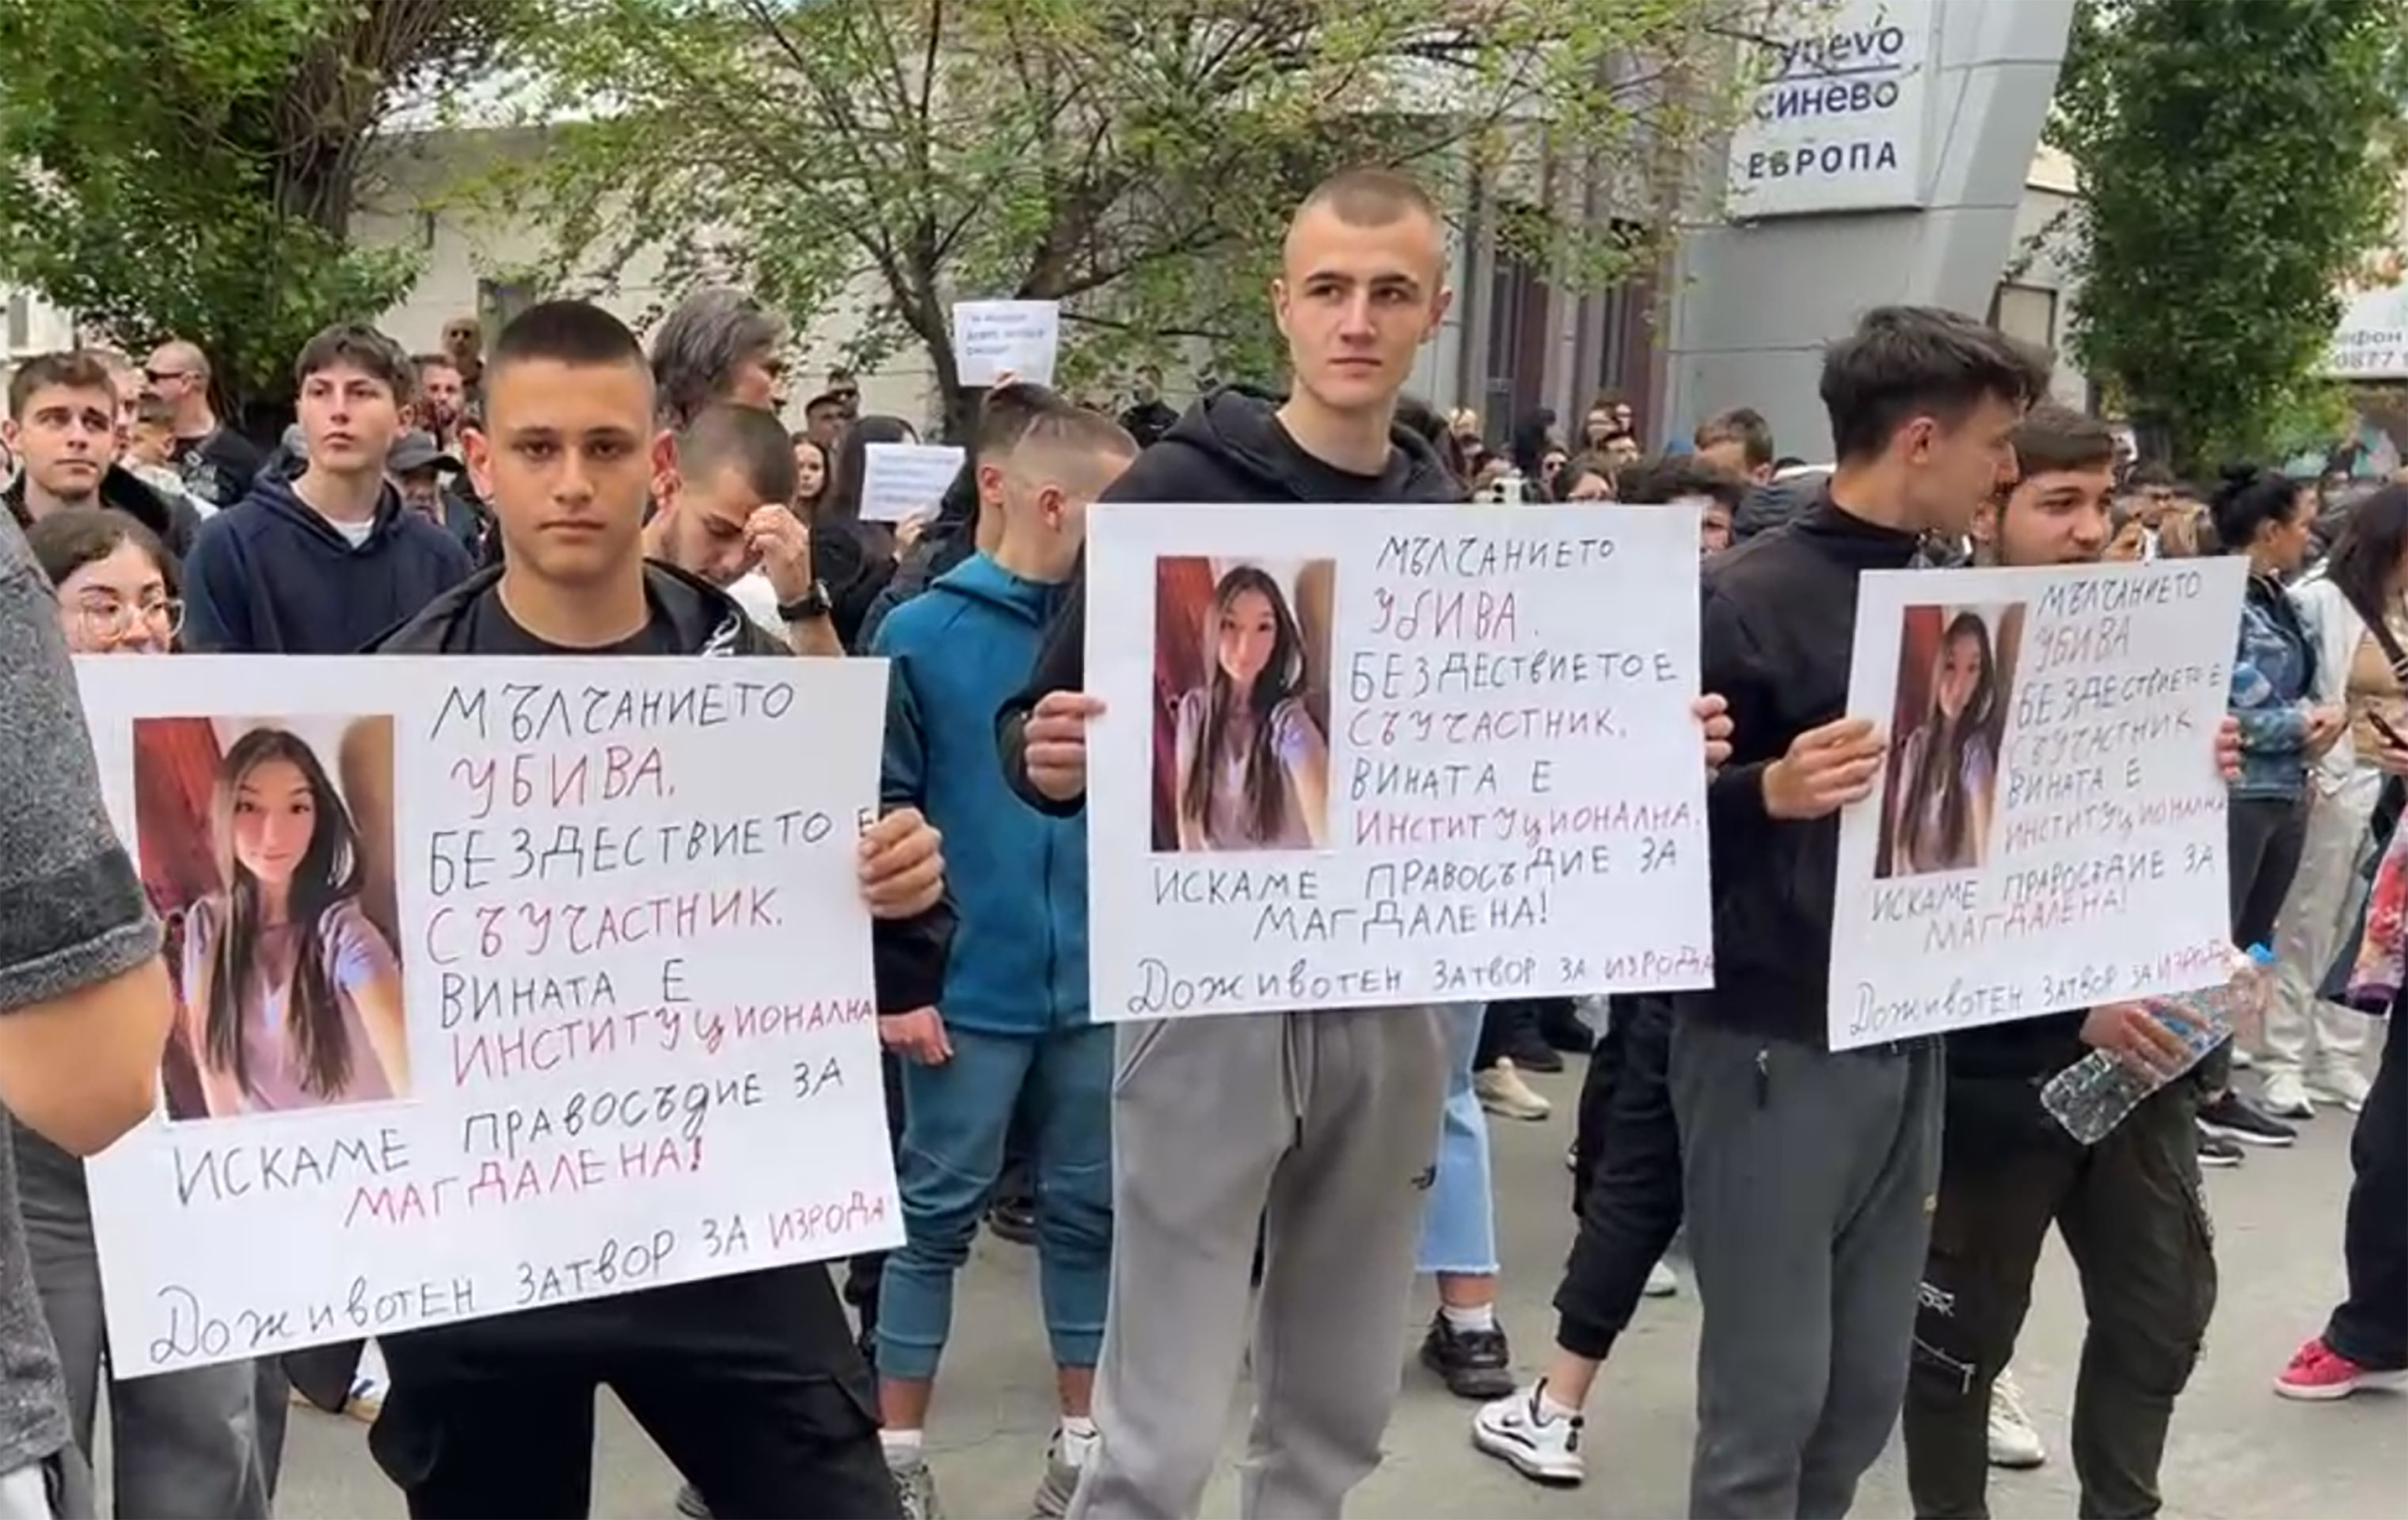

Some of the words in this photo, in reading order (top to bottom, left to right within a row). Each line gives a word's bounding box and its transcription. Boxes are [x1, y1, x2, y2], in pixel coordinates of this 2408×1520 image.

[1780, 25, 1904, 78] ynevo
[1748, 141, 1897, 180] ЕВРОПА
[1375, 535, 1615, 577] МЪЛЧАНИЕТО
[430, 682, 794, 743] МЪЛЧАНИЕТО
[1348, 707, 1626, 747] СЪУЧАСТНИК.
[450, 745, 675, 819] УБИВА.
[1351, 757, 1497, 801] ВИНАТА
[1531, 761, 1552, 793] Е
[2126, 758, 2141, 788] Е
[429, 811, 832, 896] БЕЗДЕСТВИЕТО
[1153, 866, 1318, 906] ИСКАМЕ
[1365, 846, 1610, 900] ПРАВОСЪДИЕ
[1640, 838, 1676, 874] ЗА
[1871, 880, 1978, 922] ИСКАМЕ
[2184, 843, 2214, 873] ЗА
[427, 887, 783, 966] СЪУЧАСТНИК.
[1253, 891, 1549, 943] МАГДАЛЕНА!
[441, 971, 616, 1030] ВИНАТА
[663, 959, 691, 1003] Е
[1560, 956, 1585, 982] ЗА
[453, 998, 873, 1087] ИНСТИТУЦИОНАЛНА
[173, 1130, 410, 1206] ИСКАМЕ
[793, 1057, 843, 1099] ЗА
[344, 1135, 703, 1227] МАГДАЛЕНА!
[702, 1215, 749, 1257] ЗА
[768, 1191, 884, 1248] ИЗРОДА
